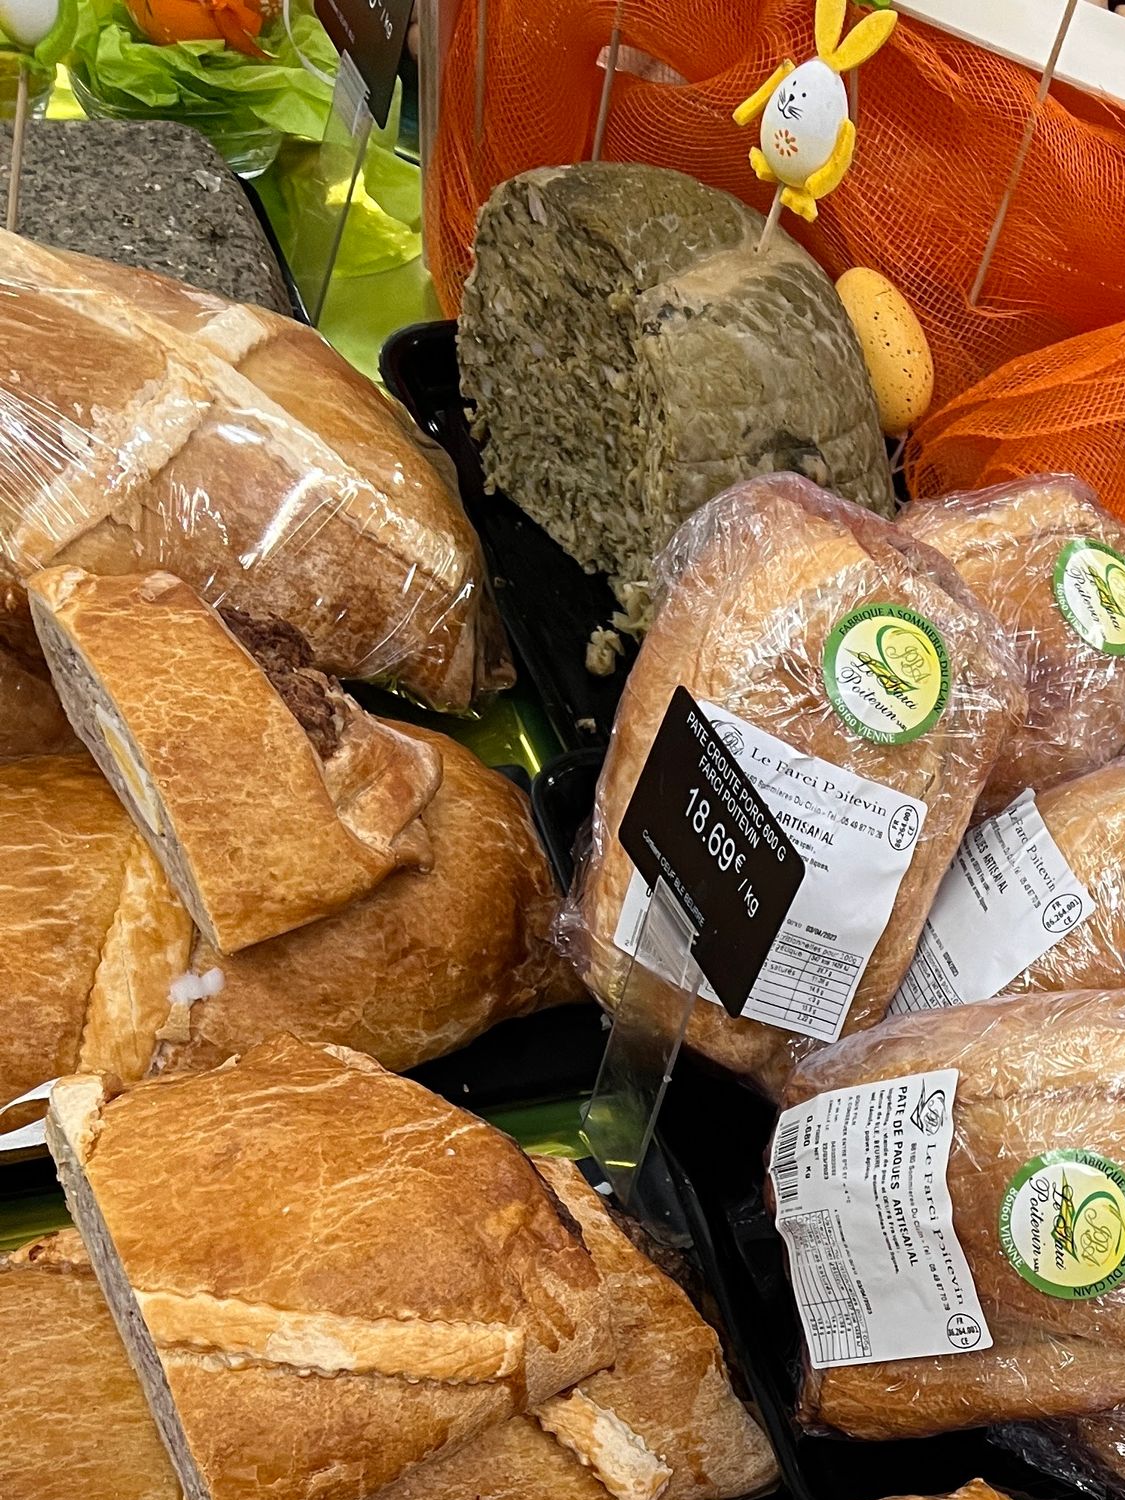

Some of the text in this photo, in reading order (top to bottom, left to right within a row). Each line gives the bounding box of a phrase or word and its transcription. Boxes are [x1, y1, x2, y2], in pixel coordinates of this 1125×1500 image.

[835, 665, 896, 721] Poitevin
[837, 607, 949, 714] FABRIQUE SOMMIERES DU CLAIN
[849, 650, 872, 677] Le
[834, 699, 895, 742] 86160 VIENNE
[684, 711, 789, 862] PATE CROUTE PORC 600 G
[696, 754, 761, 849] FARCI POITEVIN
[749, 746, 889, 818] Le Farci Poitevin
[685, 785, 748, 874] 18.69€
[742, 888, 763, 919] kg
[774, 809, 837, 846] ARTISANAL
[659, 857, 676, 880] OEUF
[672, 877, 686, 896] BLE
[682, 892, 706, 927] BEURRE
[1025, 843, 1060, 893] Poitevin
[1050, 900, 1062, 911] FR
[1062, 916, 1073, 927] CE
[890, 1085, 919, 1266] PATE DE PAQUES ARTISANAL
[923, 1142, 966, 1306] Le Farci Poitevin
[999, 1187, 1025, 1268] 86160 VIENNE
[1029, 1176, 1052, 1256] Poitevin
[1050, 1182, 1075, 1270] Le Farci
[1072, 1277, 1109, 1298] CLAIN
[1106, 1267, 1124, 1283] DU
